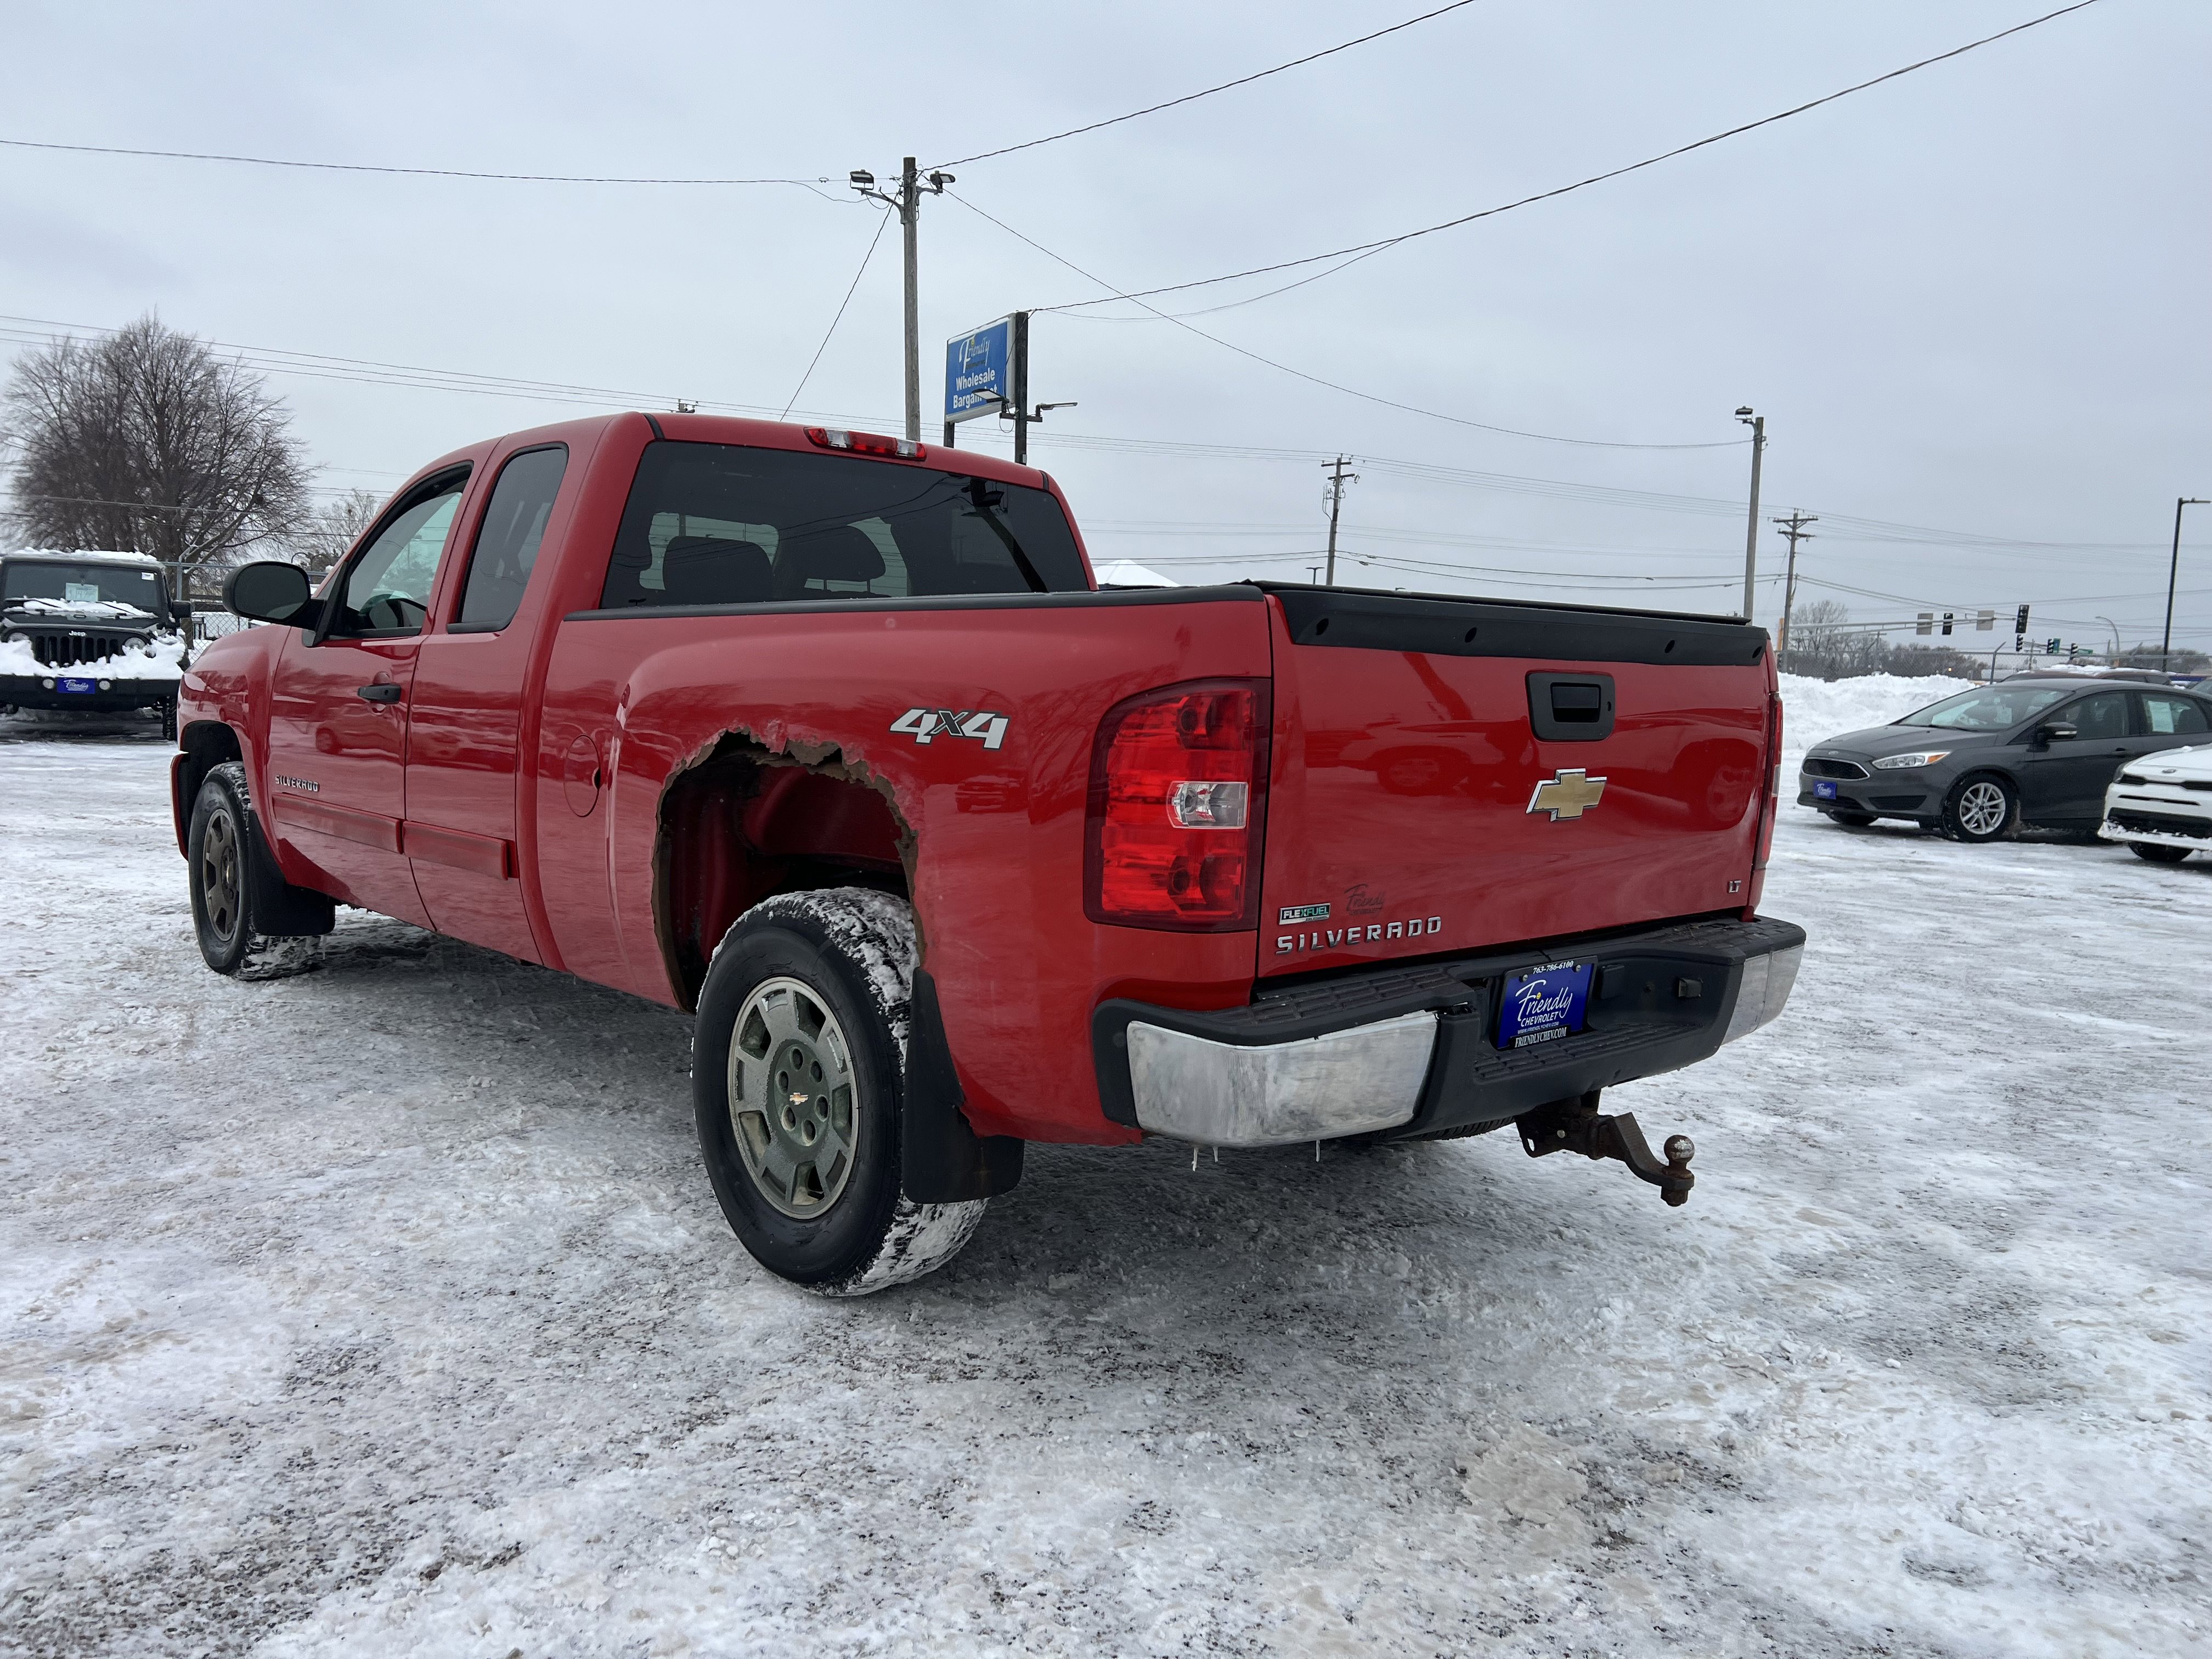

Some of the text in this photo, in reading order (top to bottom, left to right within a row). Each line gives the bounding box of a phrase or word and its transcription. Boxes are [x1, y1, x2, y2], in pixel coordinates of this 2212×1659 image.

[959, 333, 990, 373] Friendly
[956, 367, 995, 391] Wholesale
[275, 775, 319, 792] SILVERADO
[1729, 880, 1742, 893] LT
[1283, 906, 1329, 919] FLEXFUEL
[1275, 916, 1442, 955] SILVERADO
[1533, 961, 1574, 974] 763-786-6100
[1515, 979, 1573, 1022] Friendly
[1521, 1011, 1560, 1027] CHEVROLET
[1514, 1026, 1567, 1048] FRIENDLYCHEV.COM
